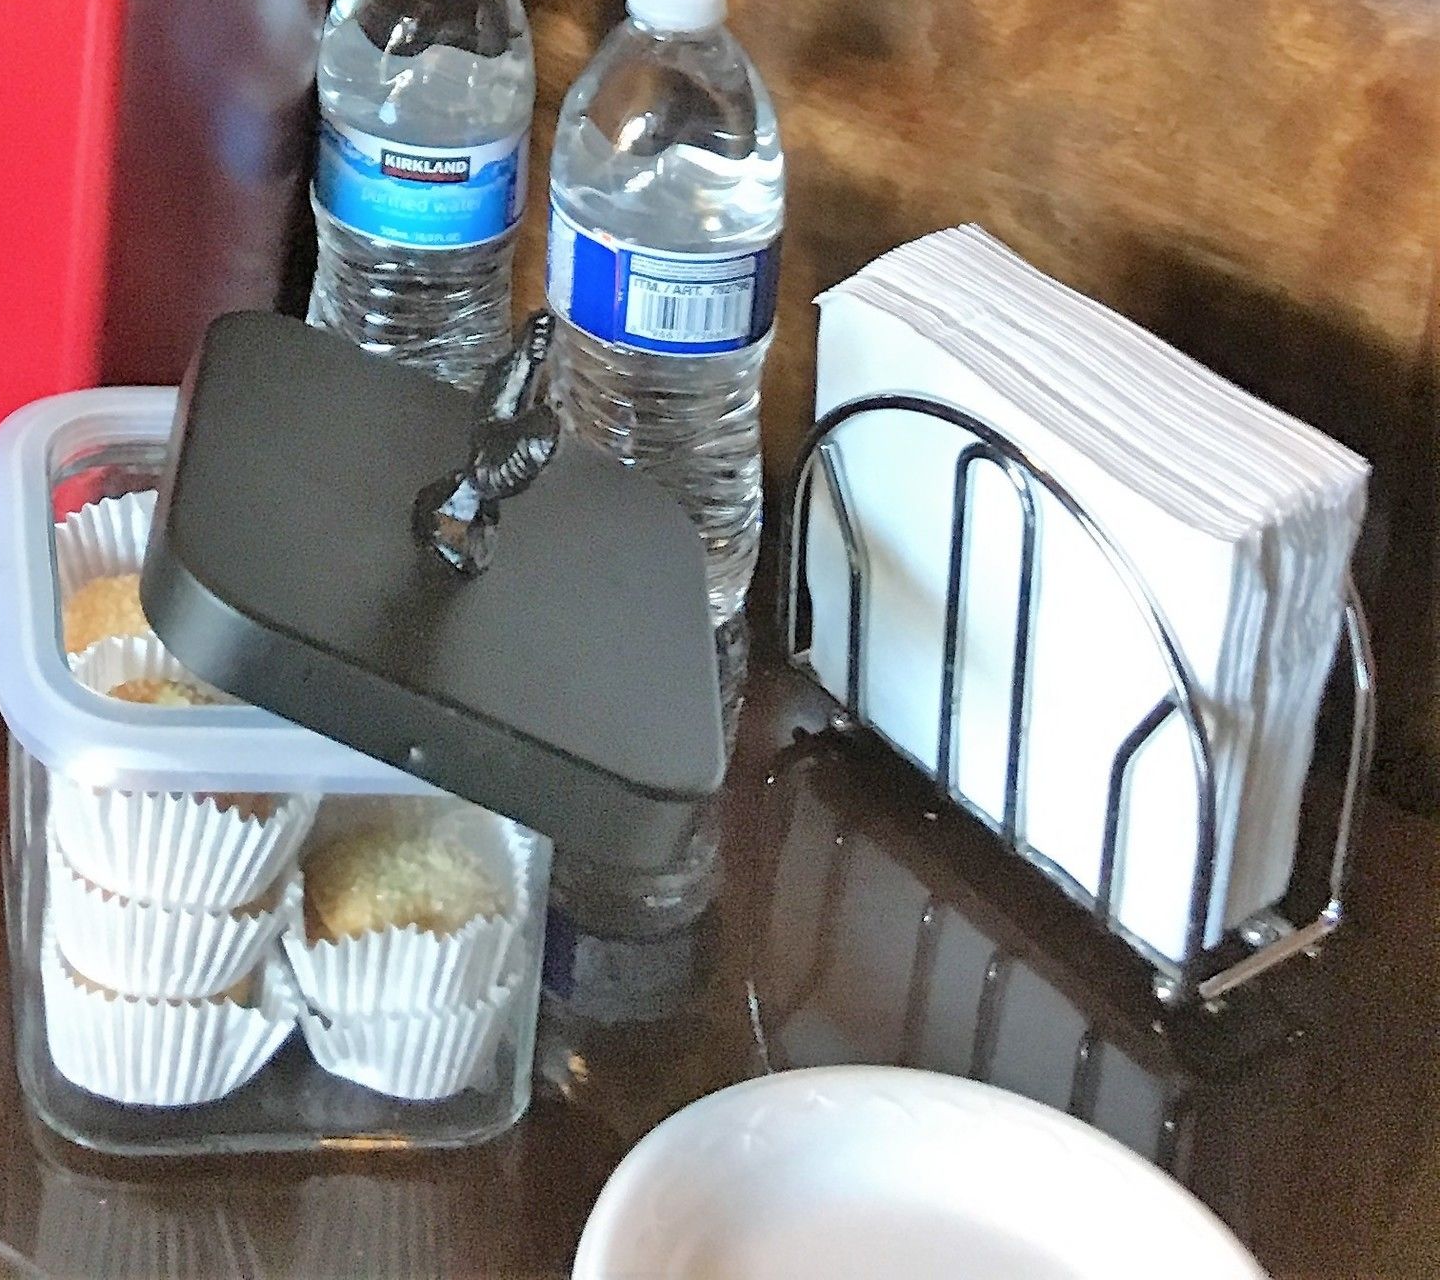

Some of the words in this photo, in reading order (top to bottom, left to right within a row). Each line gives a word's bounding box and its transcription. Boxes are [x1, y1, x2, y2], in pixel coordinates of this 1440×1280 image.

[383, 152, 470, 175] KIRKLAND
[360, 186, 430, 214] purified
[433, 194, 482, 215] water
